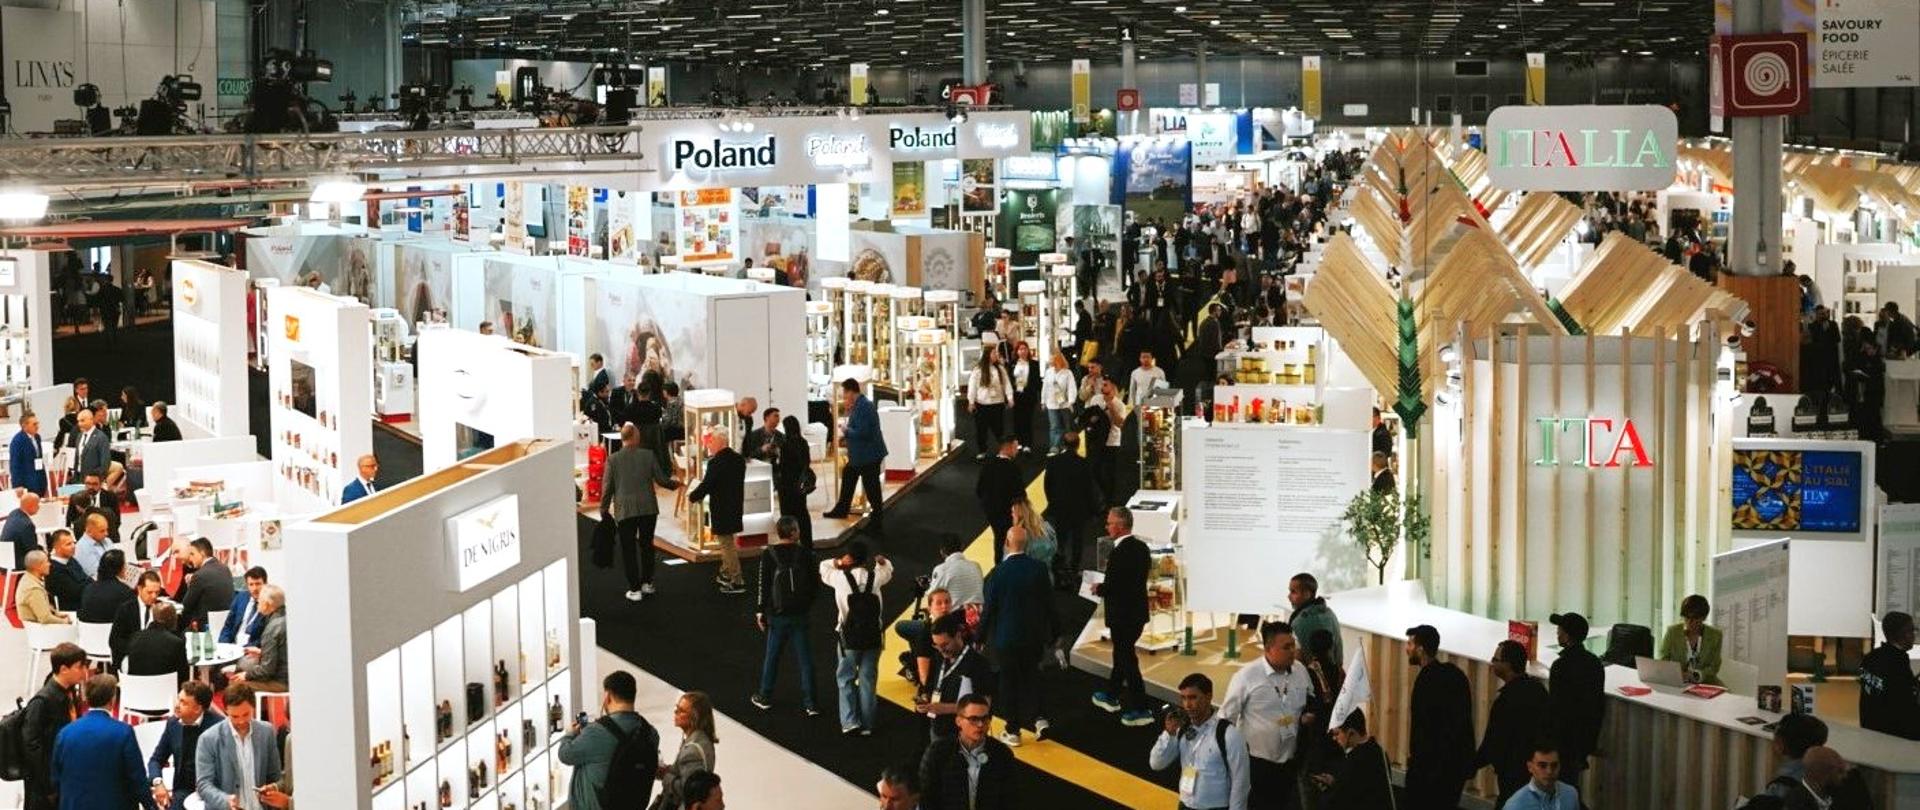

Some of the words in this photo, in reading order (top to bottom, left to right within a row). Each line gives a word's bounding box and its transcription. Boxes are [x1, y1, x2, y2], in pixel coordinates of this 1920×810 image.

[1121, 28, 1132, 41] 1
[1822, 20, 1882, 30] SAVOURY
[1822, 33, 1859, 43] FOOD
[1822, 48, 1869, 61] ÉPICERIE
[15, 60, 75, 88] LINA'S
[1822, 62, 1855, 73] SALÉE
[889, 126, 957, 149] Poland
[1498, 129, 1668, 168] ITALIA
[675, 136, 776, 170] Poland
[1535, 417, 1654, 468] ITA
[463, 544, 479, 568] DE
[481, 527, 516, 556] NIGRIS
